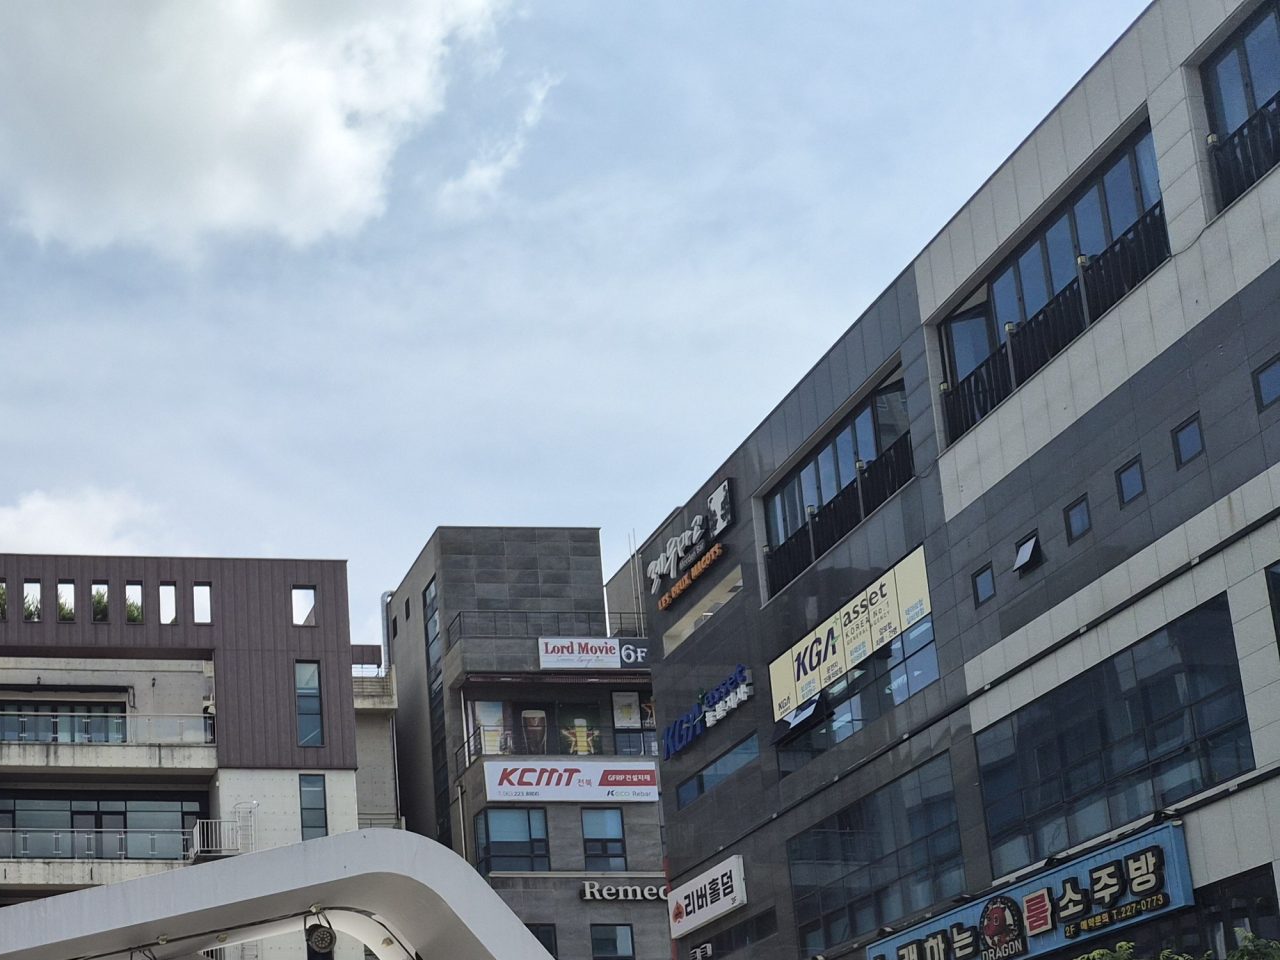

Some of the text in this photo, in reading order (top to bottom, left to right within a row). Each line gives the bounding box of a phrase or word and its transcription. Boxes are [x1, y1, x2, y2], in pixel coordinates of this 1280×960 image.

[658, 543, 723, 611] LES DEUX MAGOTS
[543, 641, 575, 655] Lord
[577, 641, 617, 655] Movie
[621, 644, 648, 664] 6F
[794, 627, 836, 682] KGA
[842, 582, 888, 628] asset
[683, 869, 734, 917] 리버홀덤
[1111, 894, 1164, 922] T.227-0773
